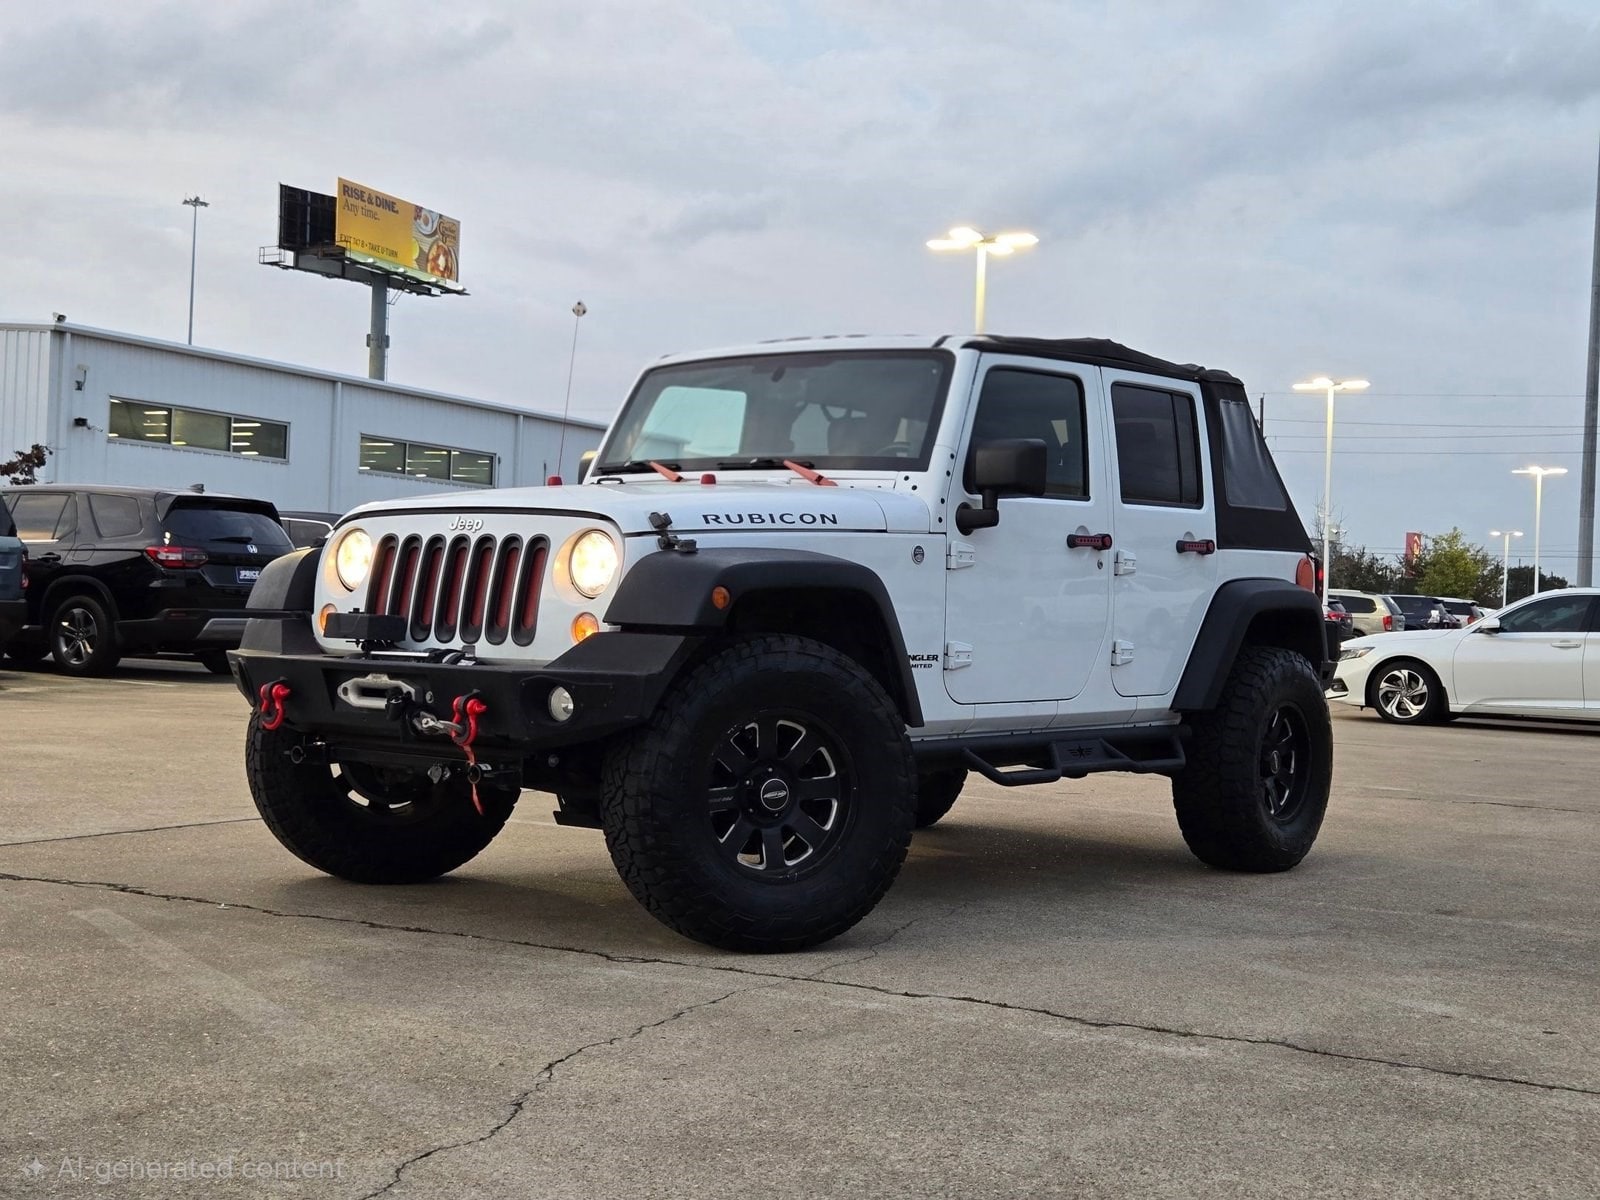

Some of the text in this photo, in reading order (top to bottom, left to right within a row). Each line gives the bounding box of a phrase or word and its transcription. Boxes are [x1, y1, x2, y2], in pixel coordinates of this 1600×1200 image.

[343, 184, 399, 214] RISE & DINE.
[343, 199, 380, 221] Any time.
[368, 242, 380, 254] TAKE
[449, 516, 484, 533] Jeep
[702, 513, 838, 525] RUBICON
